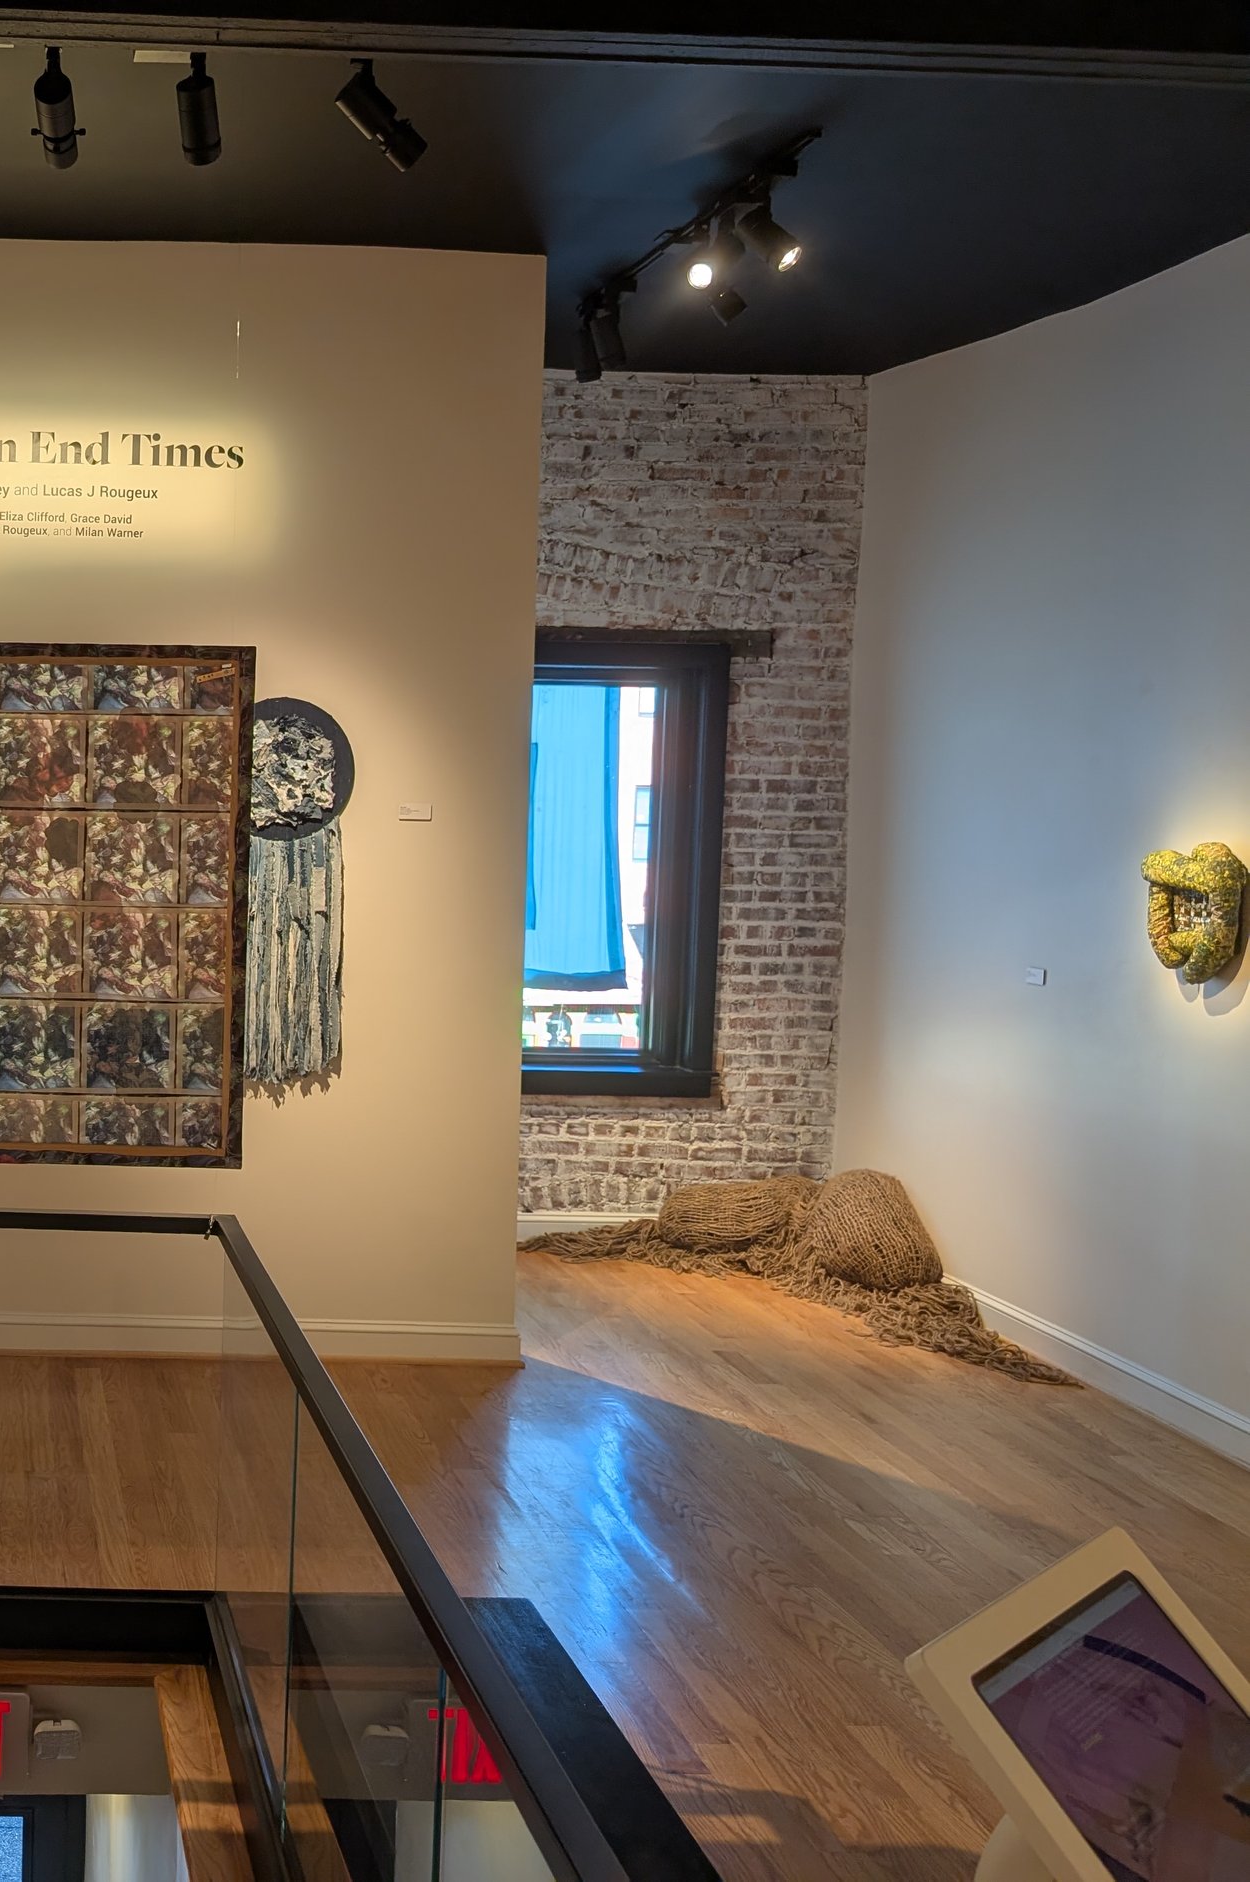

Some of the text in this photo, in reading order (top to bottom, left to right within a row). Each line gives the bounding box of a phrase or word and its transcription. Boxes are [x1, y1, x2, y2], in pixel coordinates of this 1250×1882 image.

[29, 430, 110, 465] End
[121, 432, 246, 471] Times
[14, 483, 39, 496] and
[43, 484, 83, 497] Lucas
[87, 485, 95, 498] J
[100, 486, 158, 502] Rougeux
[0, 511, 24, 522] Eliza
[27, 512, 67, 524] Clifford,
[70, 513, 101, 524] Grace
[103, 514, 133, 525] David
[3, 525, 50, 538] Rougeux,
[53, 526, 72, 537] and
[75, 527, 104, 538] Milan
[106, 528, 144, 539] Warner
